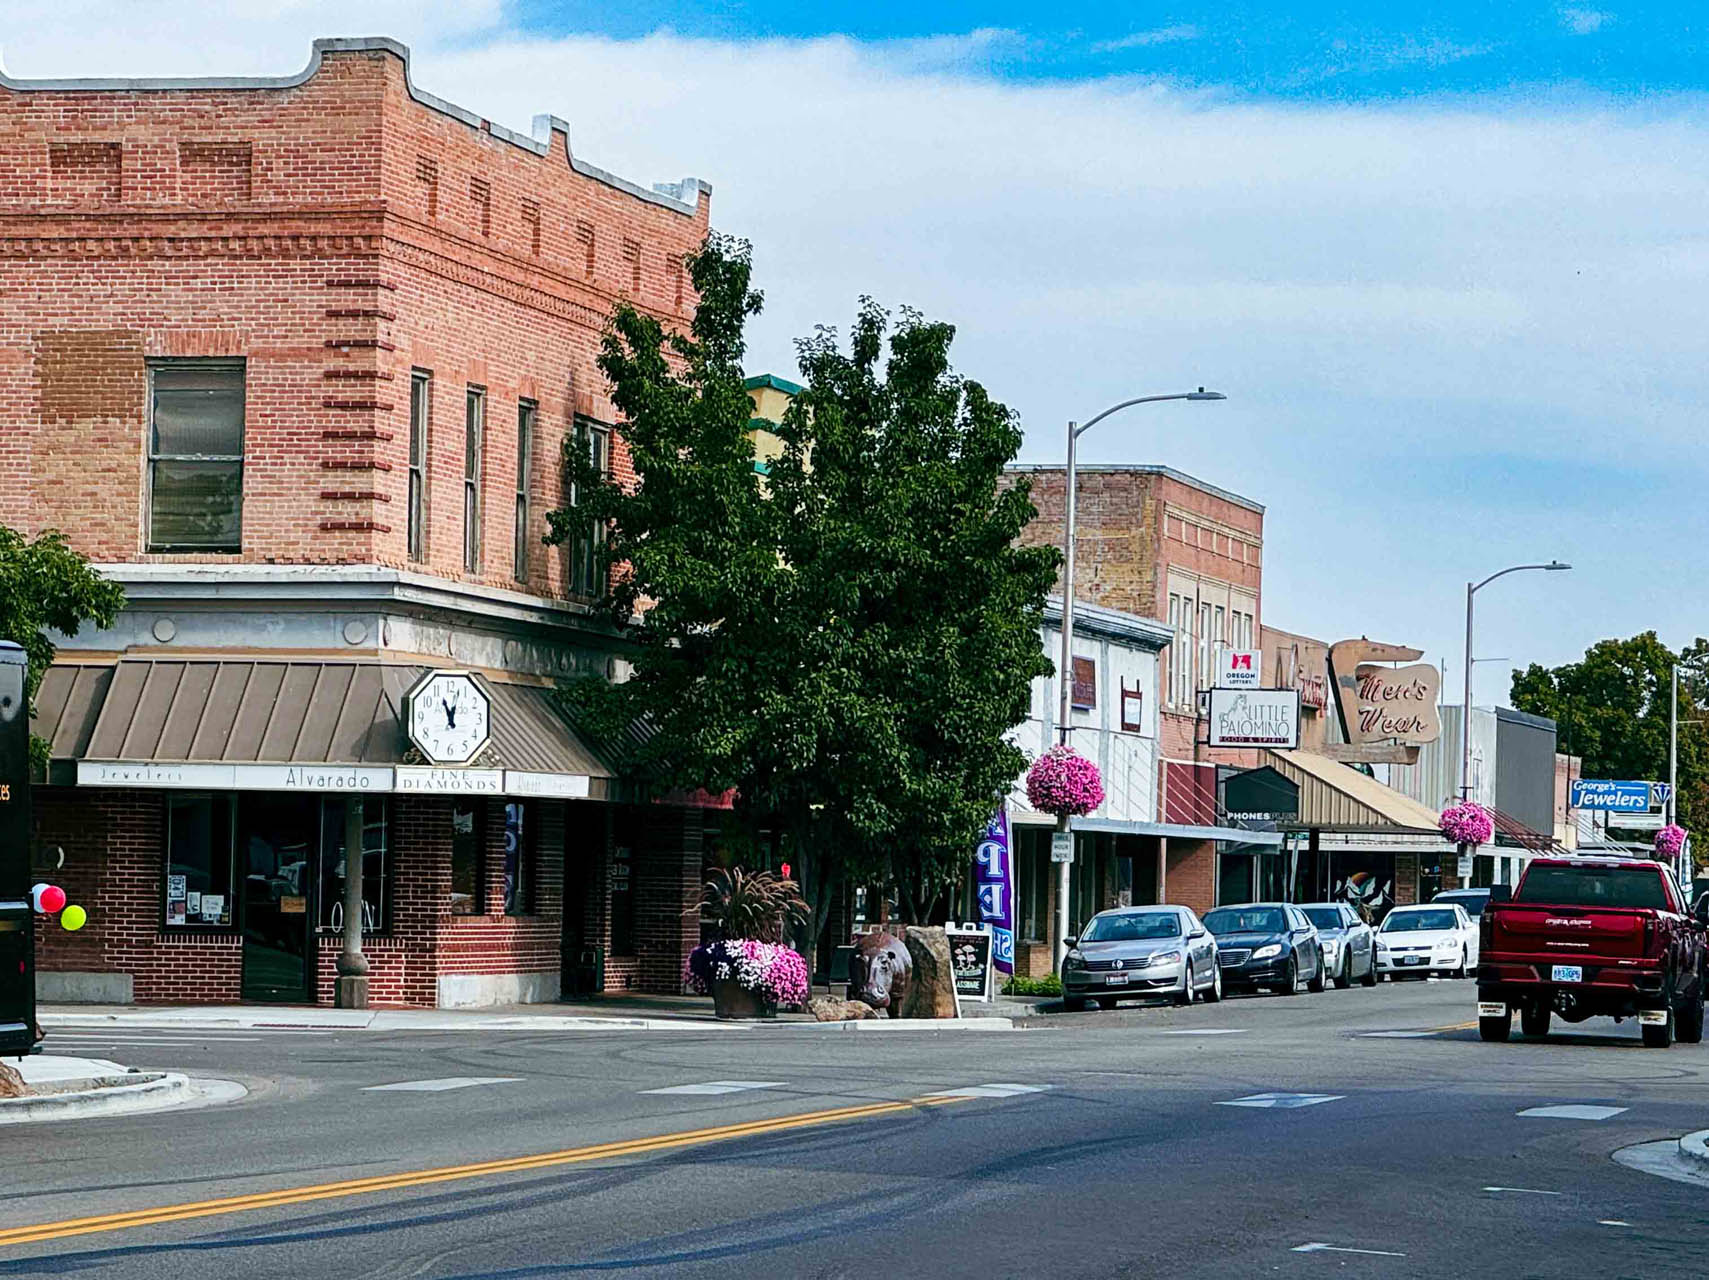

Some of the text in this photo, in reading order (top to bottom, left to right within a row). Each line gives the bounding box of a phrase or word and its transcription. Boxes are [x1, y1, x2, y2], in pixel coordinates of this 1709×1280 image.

[1226, 672, 1256, 680] OREGON
[433, 685, 440, 697] 11
[446, 680, 455, 694] 12
[463, 686, 468, 698] 1
[1355, 672, 1428, 704] Men's
[423, 696, 433, 708] 10
[472, 697, 478, 710] 2
[418, 711, 425, 724] 9
[1247, 704, 1290, 721] LITTLE
[476, 712, 482, 726] 3
[1357, 707, 1429, 734] Wear
[422, 728, 430, 740] 8
[1219, 720, 1290, 737] PALOMINO
[471, 730, 478, 741] 4
[434, 740, 440, 753] 7
[447, 744, 454, 756] 6
[462, 741, 468, 753] 5
[286, 768, 370, 788] Alvarado
[431, 771, 470, 780] FINE
[403, 779, 497, 790] DIAMONDS
[1573, 781, 1617, 792] George's
[1574, 790, 1646, 807] Jewelers
